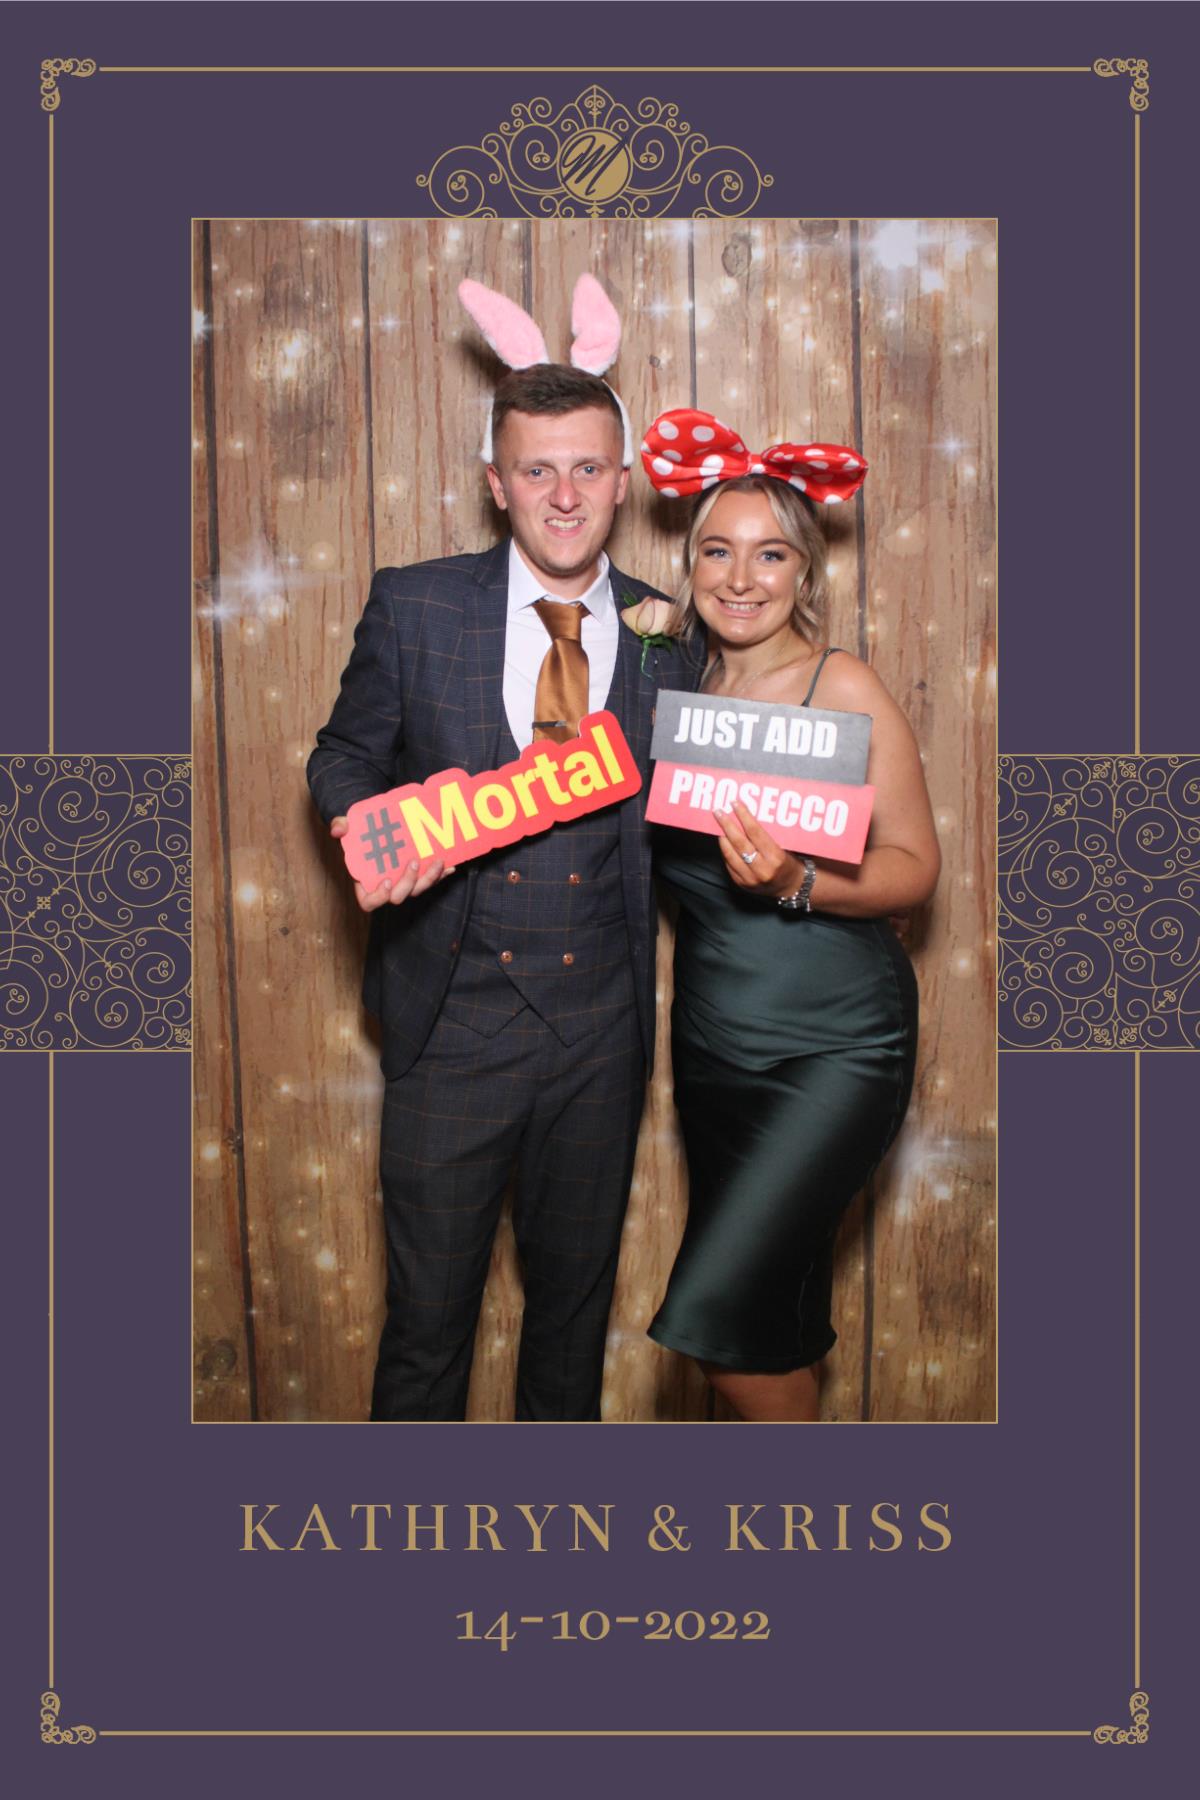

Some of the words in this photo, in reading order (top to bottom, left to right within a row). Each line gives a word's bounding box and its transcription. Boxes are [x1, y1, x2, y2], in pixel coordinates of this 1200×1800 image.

[674, 706, 760, 751] JUST
[762, 716, 838, 759] ADD
[361, 724, 625, 873] #Mortal
[668, 768, 849, 837] PROSECCO
